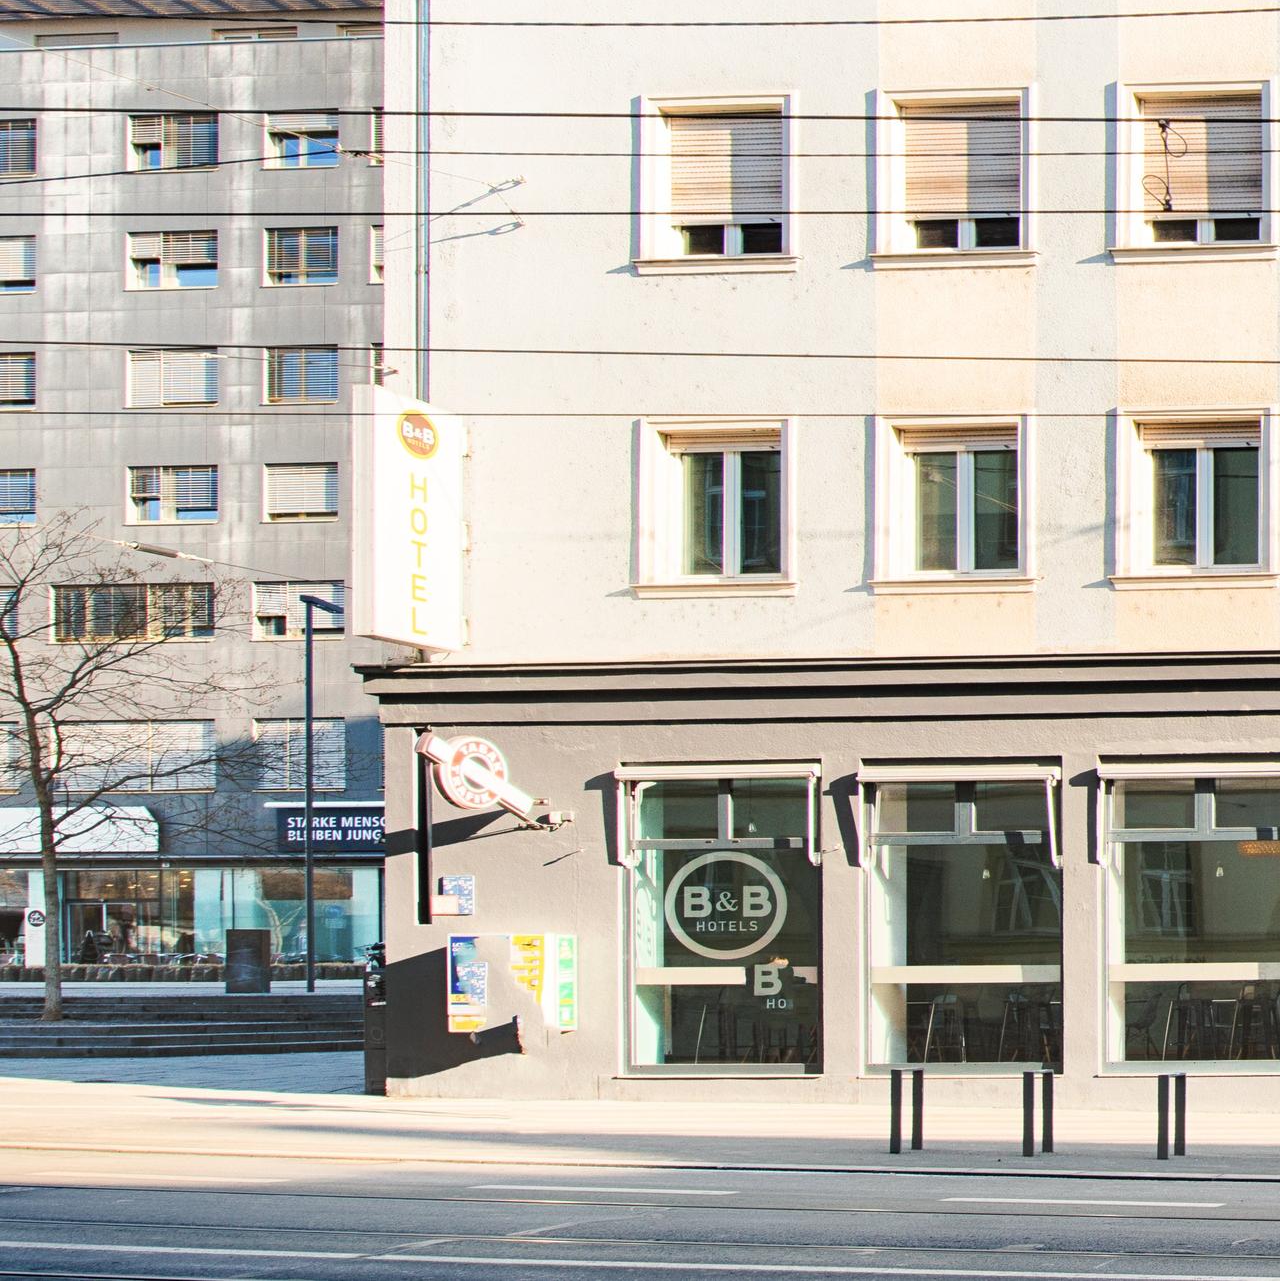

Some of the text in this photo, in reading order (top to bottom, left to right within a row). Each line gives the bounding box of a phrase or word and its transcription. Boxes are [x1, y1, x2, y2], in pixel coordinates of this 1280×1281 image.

[403, 420, 435, 446] B&B
[410, 472, 428, 636] HOTEL
[460, 742, 504, 772] TABAK
[451, 765, 490, 805] TRAFIK
[683, 885, 772, 918] B&B
[696, 920, 758, 932] HOTELS
